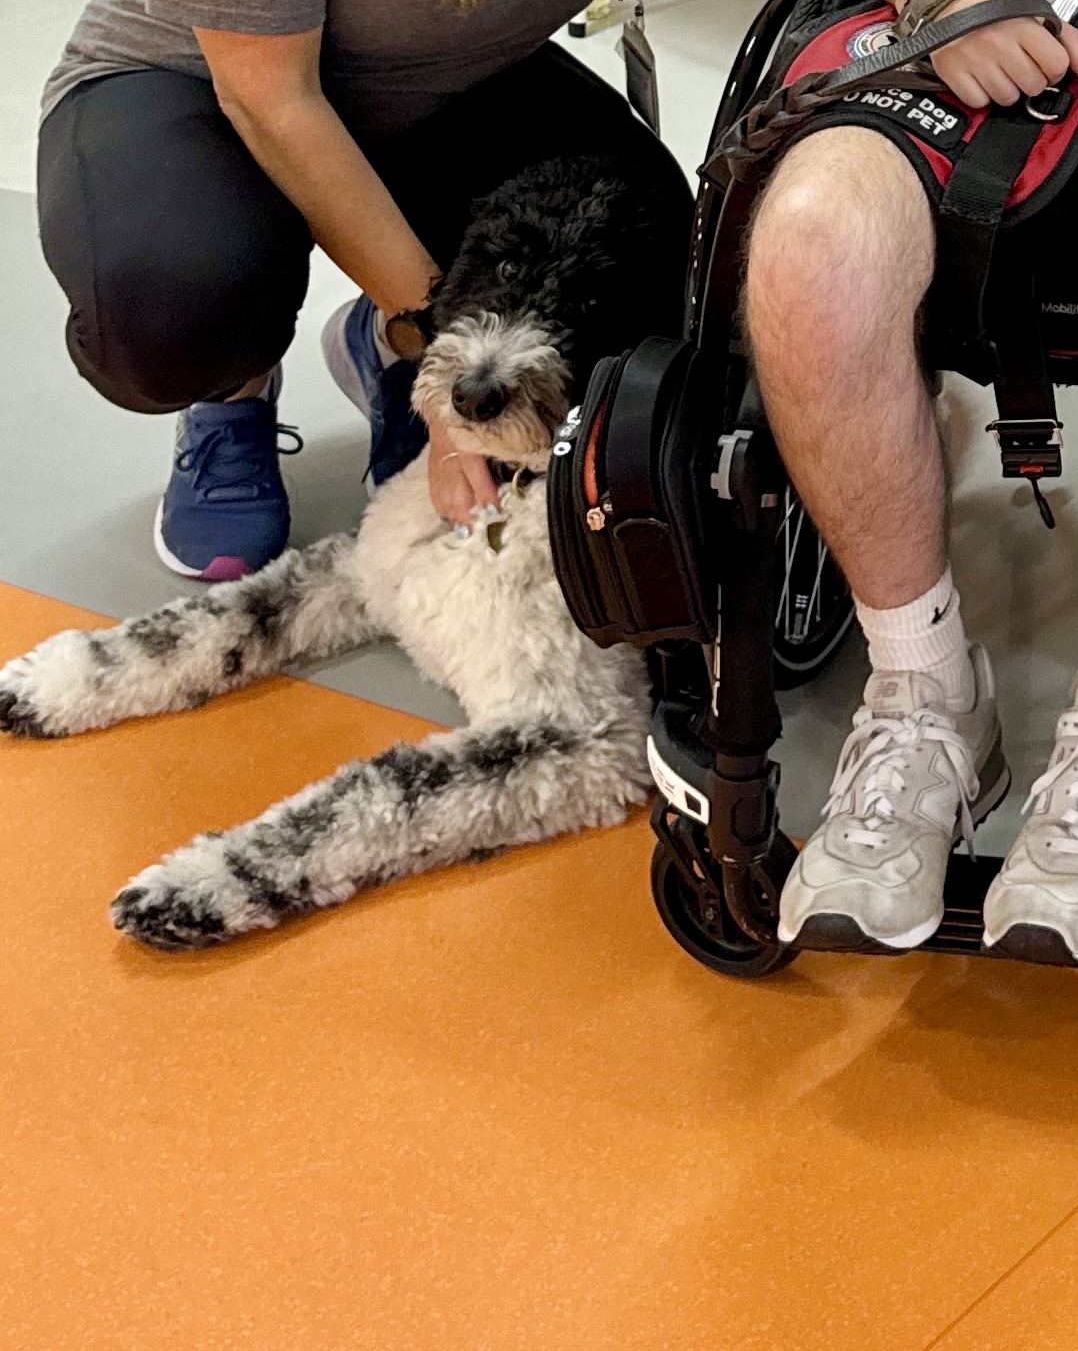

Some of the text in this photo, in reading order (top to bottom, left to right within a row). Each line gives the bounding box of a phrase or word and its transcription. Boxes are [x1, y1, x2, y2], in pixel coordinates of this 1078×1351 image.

[860, 91, 907, 112] NOT
[906, 107, 947, 136] PET
[919, 97, 959, 130] Dog
